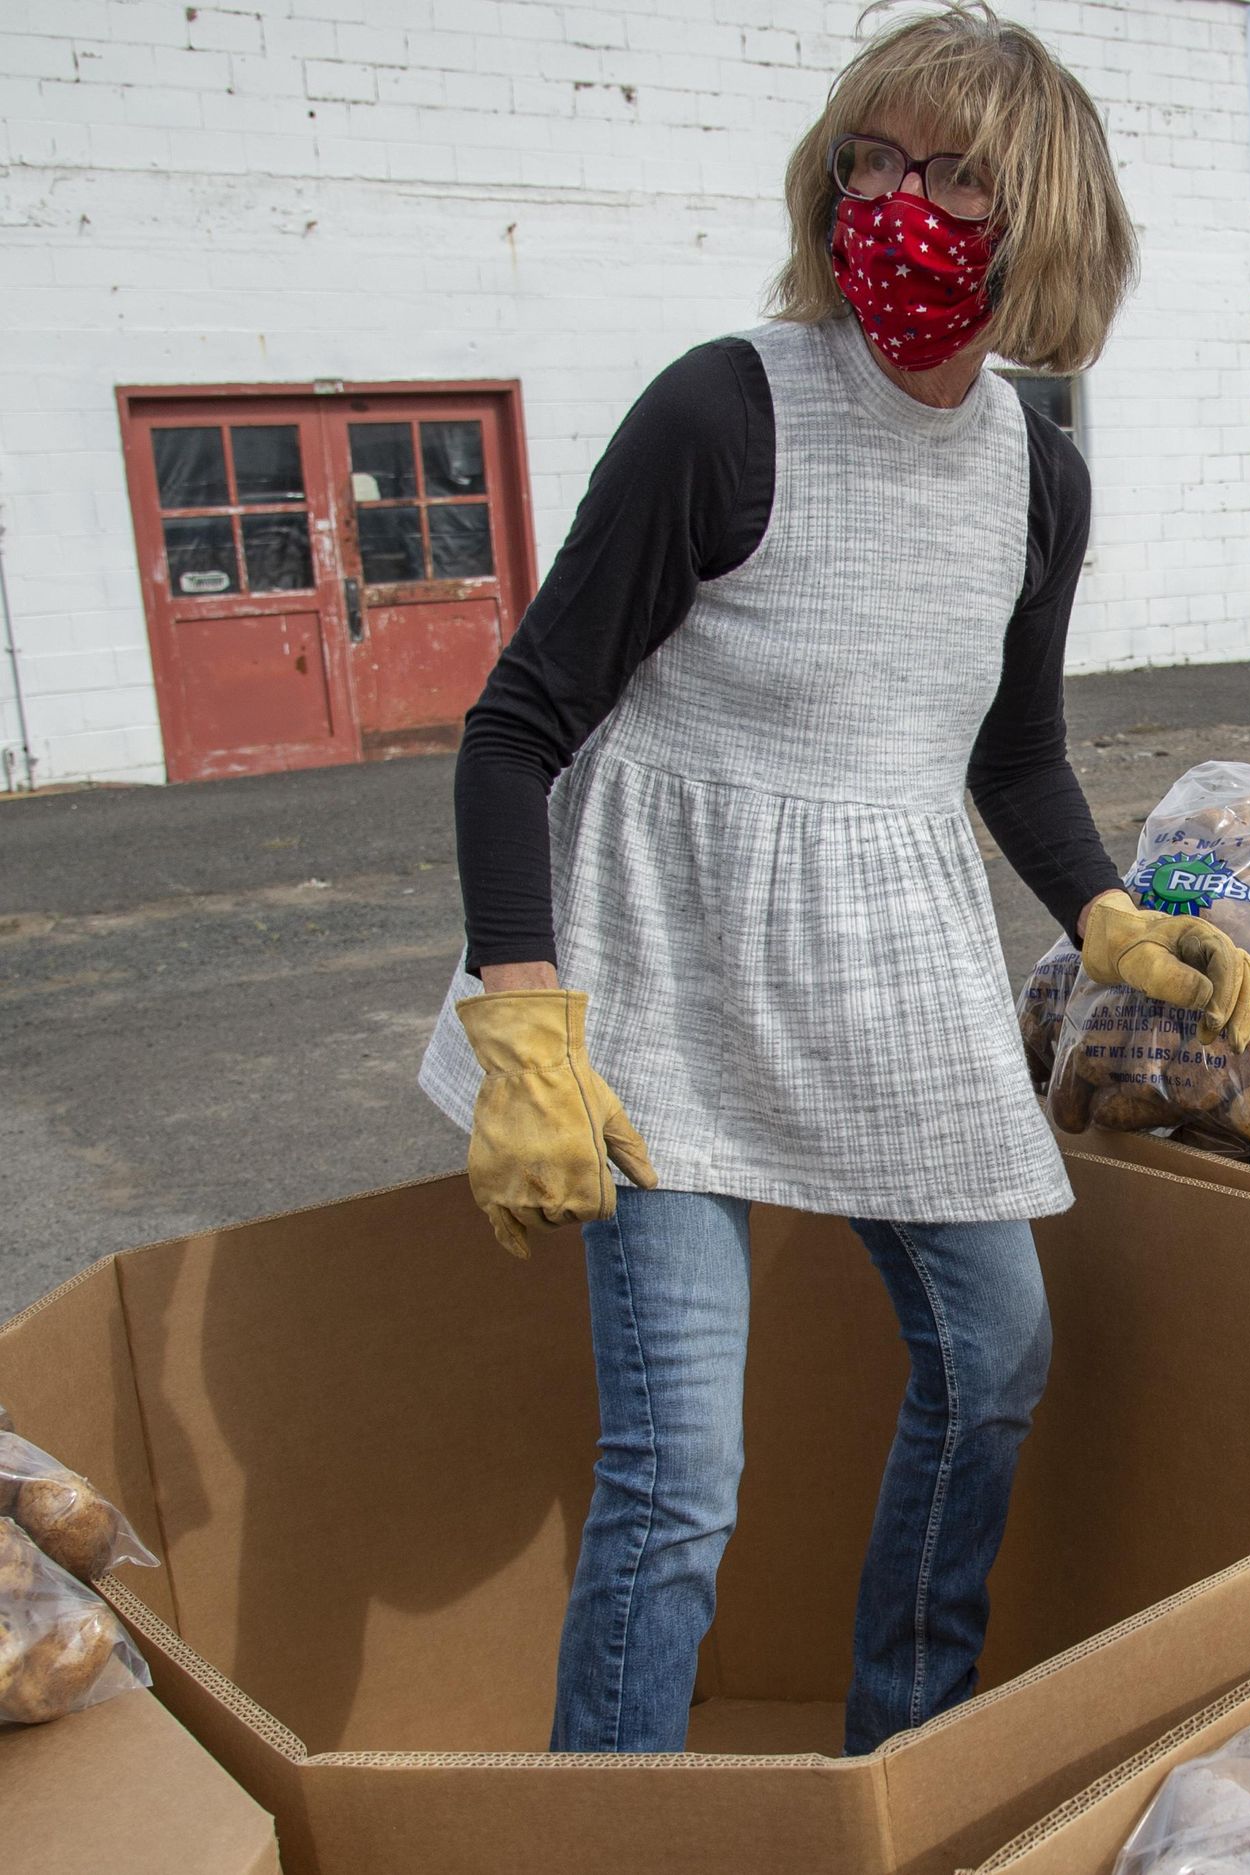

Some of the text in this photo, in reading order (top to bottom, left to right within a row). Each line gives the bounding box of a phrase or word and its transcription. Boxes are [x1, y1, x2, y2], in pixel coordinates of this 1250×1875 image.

[1091, 1005, 1203, 1022] J.R. SIMPLOT COMP
[1082, 1018, 1114, 1031] IDAHO
[1159, 1020, 1197, 1036] IDAHO
[1085, 1045, 1106, 1057] NET
[1109, 1046, 1127, 1059] WT.
[1131, 1047, 1144, 1059] 15
[1147, 1047, 1174, 1061] LBS.
[1206, 1054, 1228, 1069] kg)
